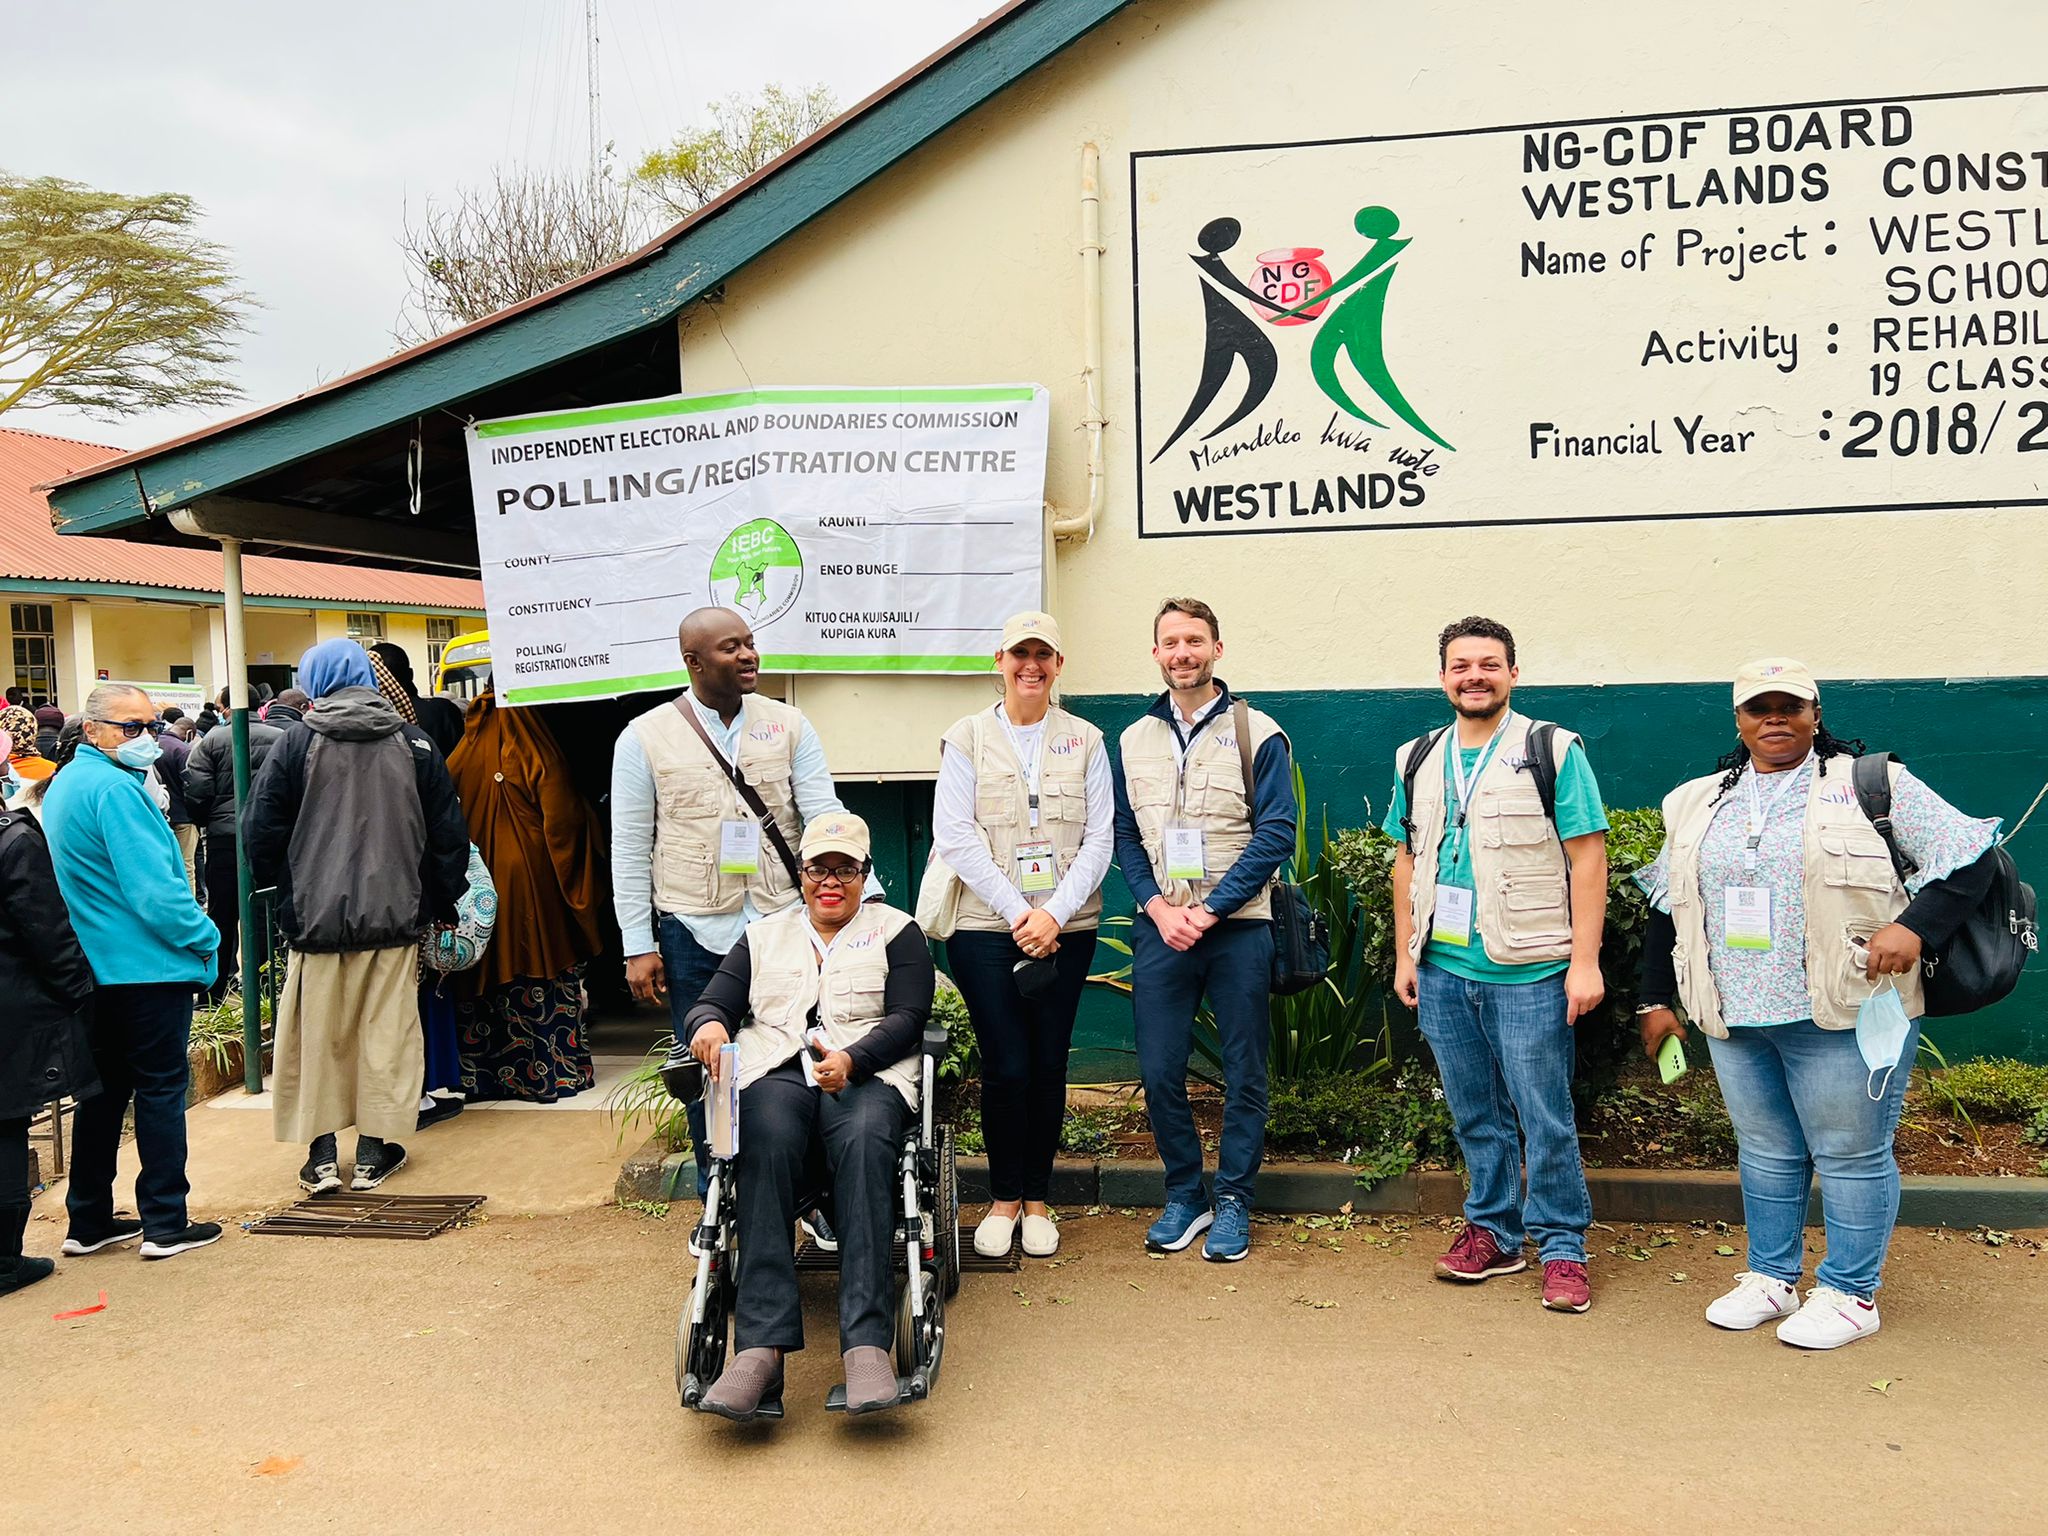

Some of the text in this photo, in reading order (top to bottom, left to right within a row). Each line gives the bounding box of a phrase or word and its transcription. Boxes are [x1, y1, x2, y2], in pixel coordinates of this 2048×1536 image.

[1523, 105, 1913, 173] NG-CDF BOARD
[1521, 163, 1829, 221] WESTLANDS
[1521, 241, 1606, 278] Name
[1621, 232, 1656, 272] of
[1676, 224, 1808, 282] Project
[1869, 208, 2048, 255] WESTL
[1263, 279, 1321, 304] CDF
[1885, 258, 2048, 306] SCHOO
[1641, 325, 1798, 374] Activity
[1873, 310, 2048, 353] REHABIL
[1870, 361, 1901, 397] 19
[491, 411, 1018, 465] INDEPENDENT ELECTORAL AND BOUNDARIES COMMISSION
[1189, 418, 1301, 471] Maendeleo
[1320, 411, 1372, 452] kwa
[1529, 419, 1663, 459] Financial
[1673, 415, 1755, 455] Year
[904, 450, 1017, 473] CENTRE
[1173, 470, 1426, 524] WESTLANDS
[819, 516, 866, 527] KAUNTI
[732, 526, 774, 553] IEBC
[504, 554, 551, 569] COUNTY
[820, 563, 898, 575] ENEO BUNGE
[508, 598, 592, 616] CONSTITUENCY
[805, 612, 837, 623] KITUO
[839, 612, 860, 623] CHA
[862, 611, 913, 623] KUJISAJILI
[820, 628, 897, 639] KUPIGIA KURA
[515, 653, 611, 674] REGISTRATION CENTRE
[516, 643, 567, 658] POLLING/
